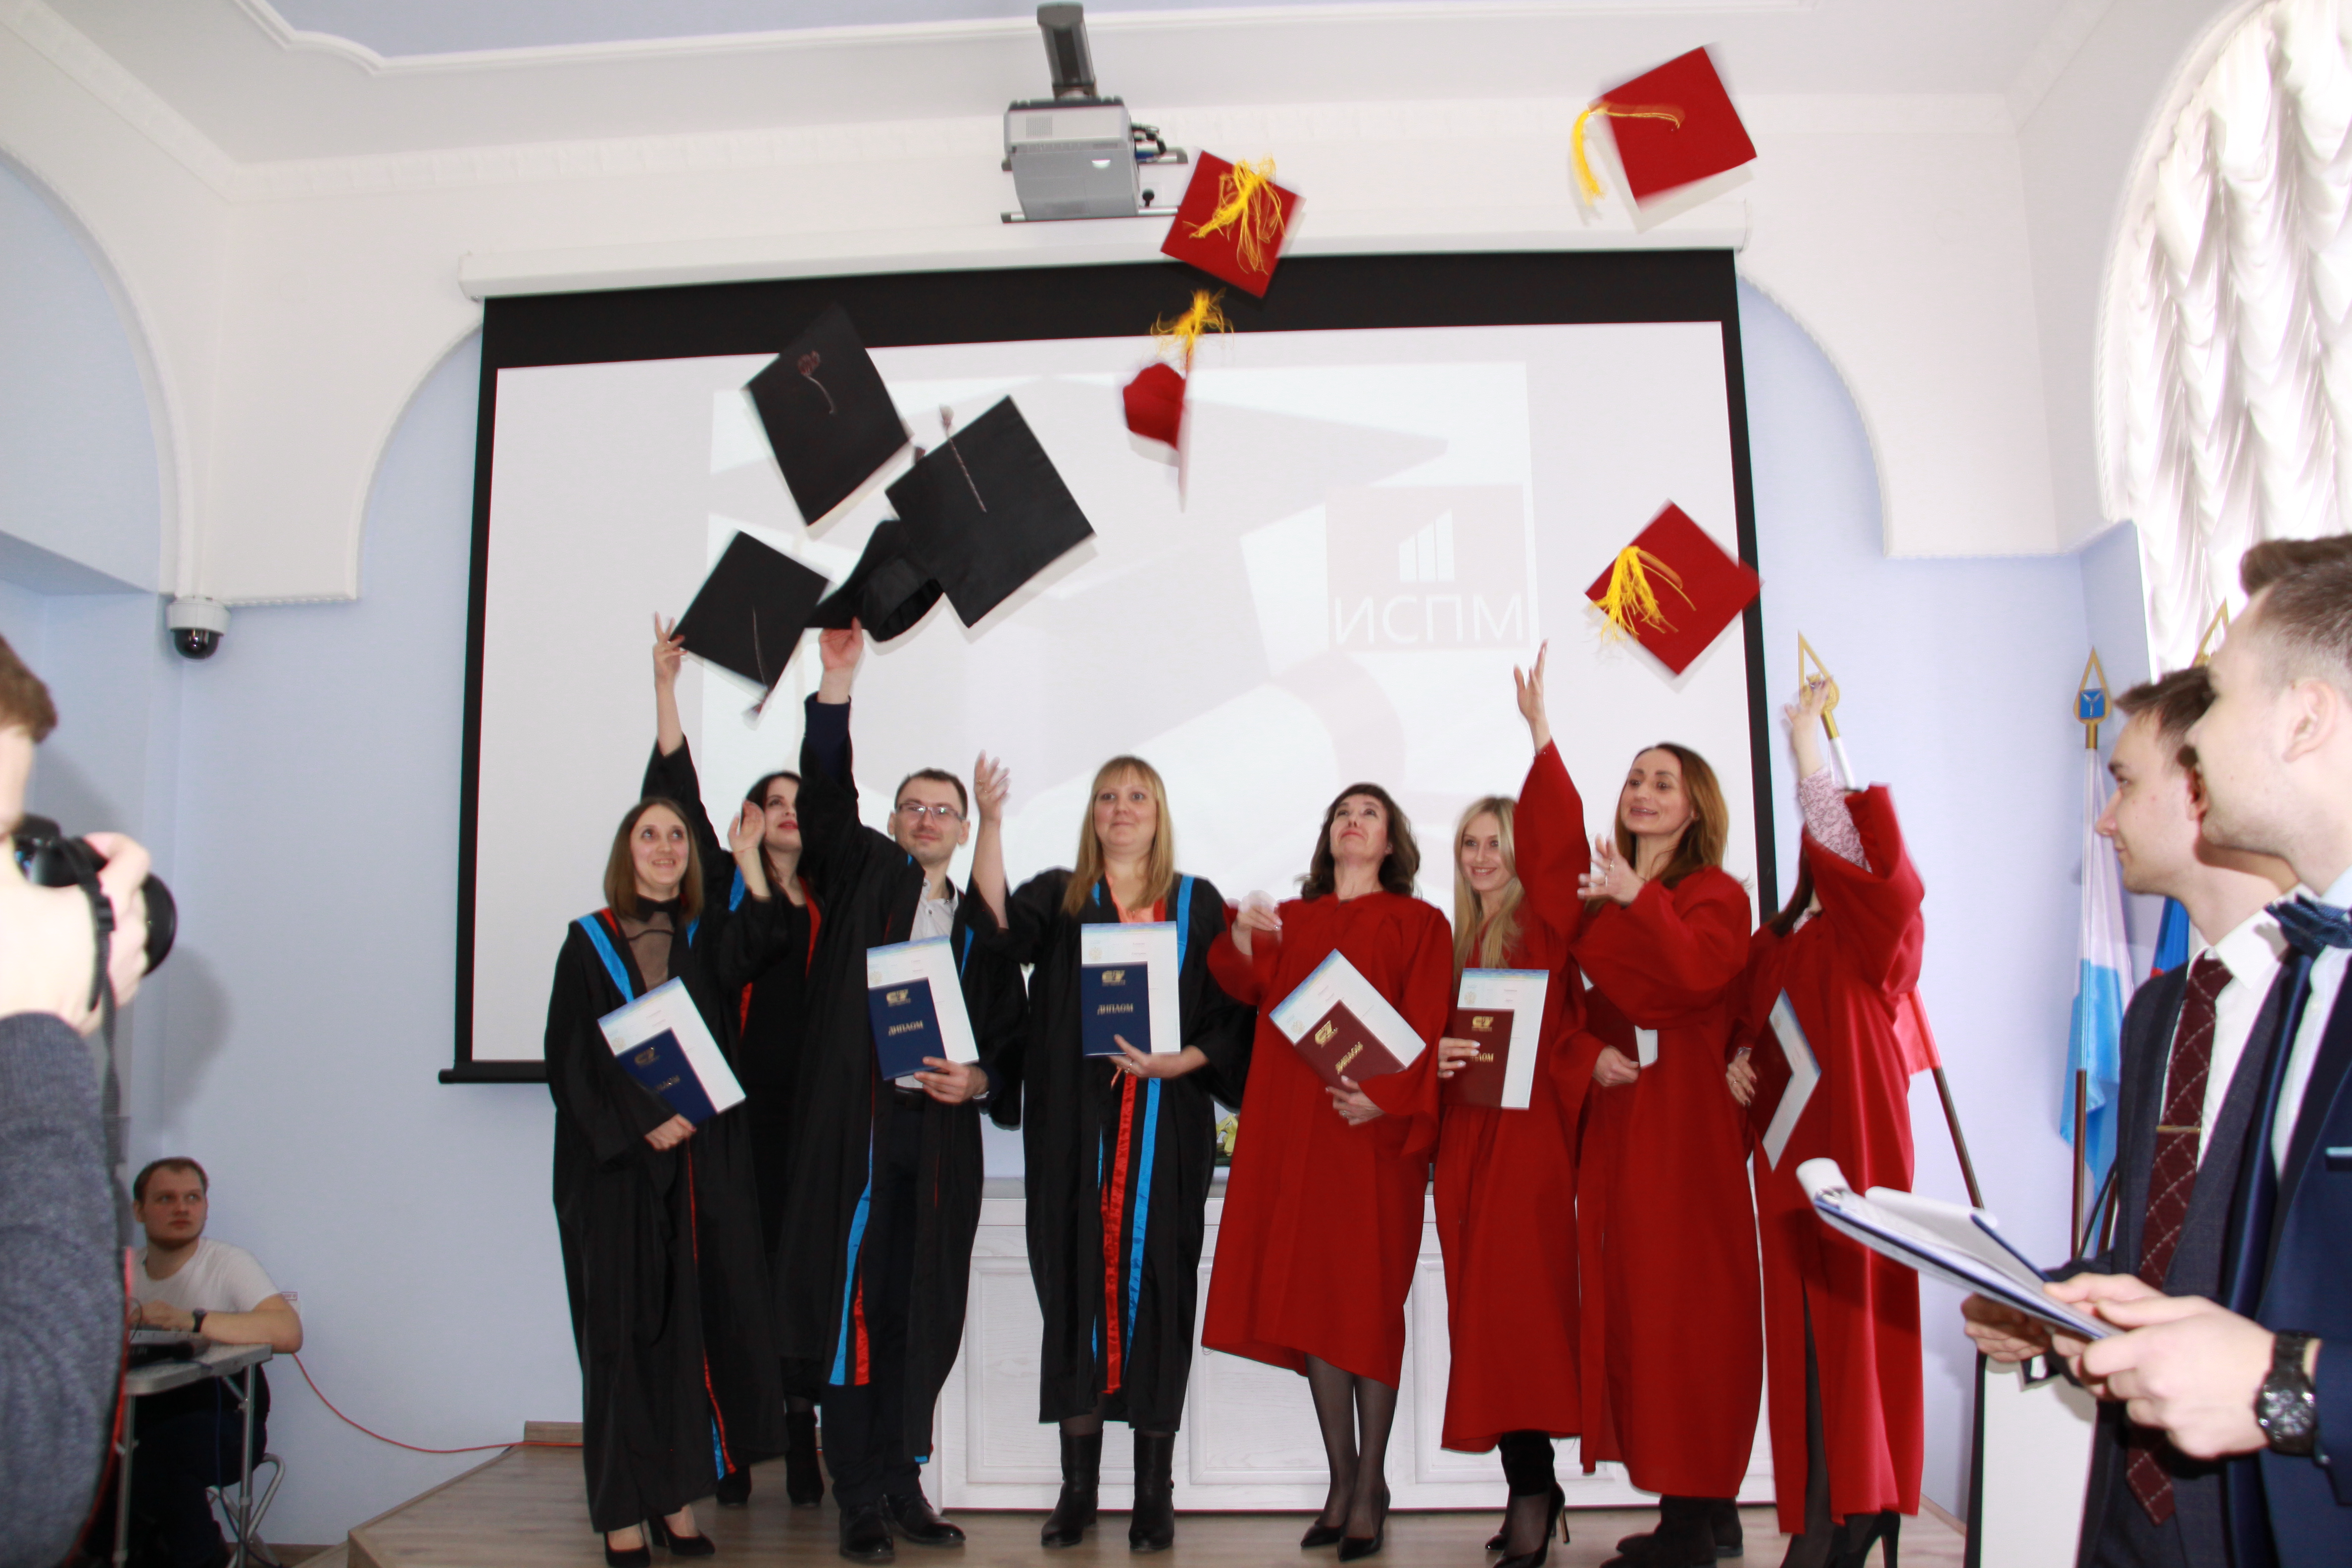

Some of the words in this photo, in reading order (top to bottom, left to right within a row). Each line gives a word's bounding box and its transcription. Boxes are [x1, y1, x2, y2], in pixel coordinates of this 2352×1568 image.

[1335, 596, 1523, 644] ИСПМ
[1097, 1003, 1133, 1015] ДИПЛОМ
[888, 1021, 923, 1036] ДИПЛОМ
